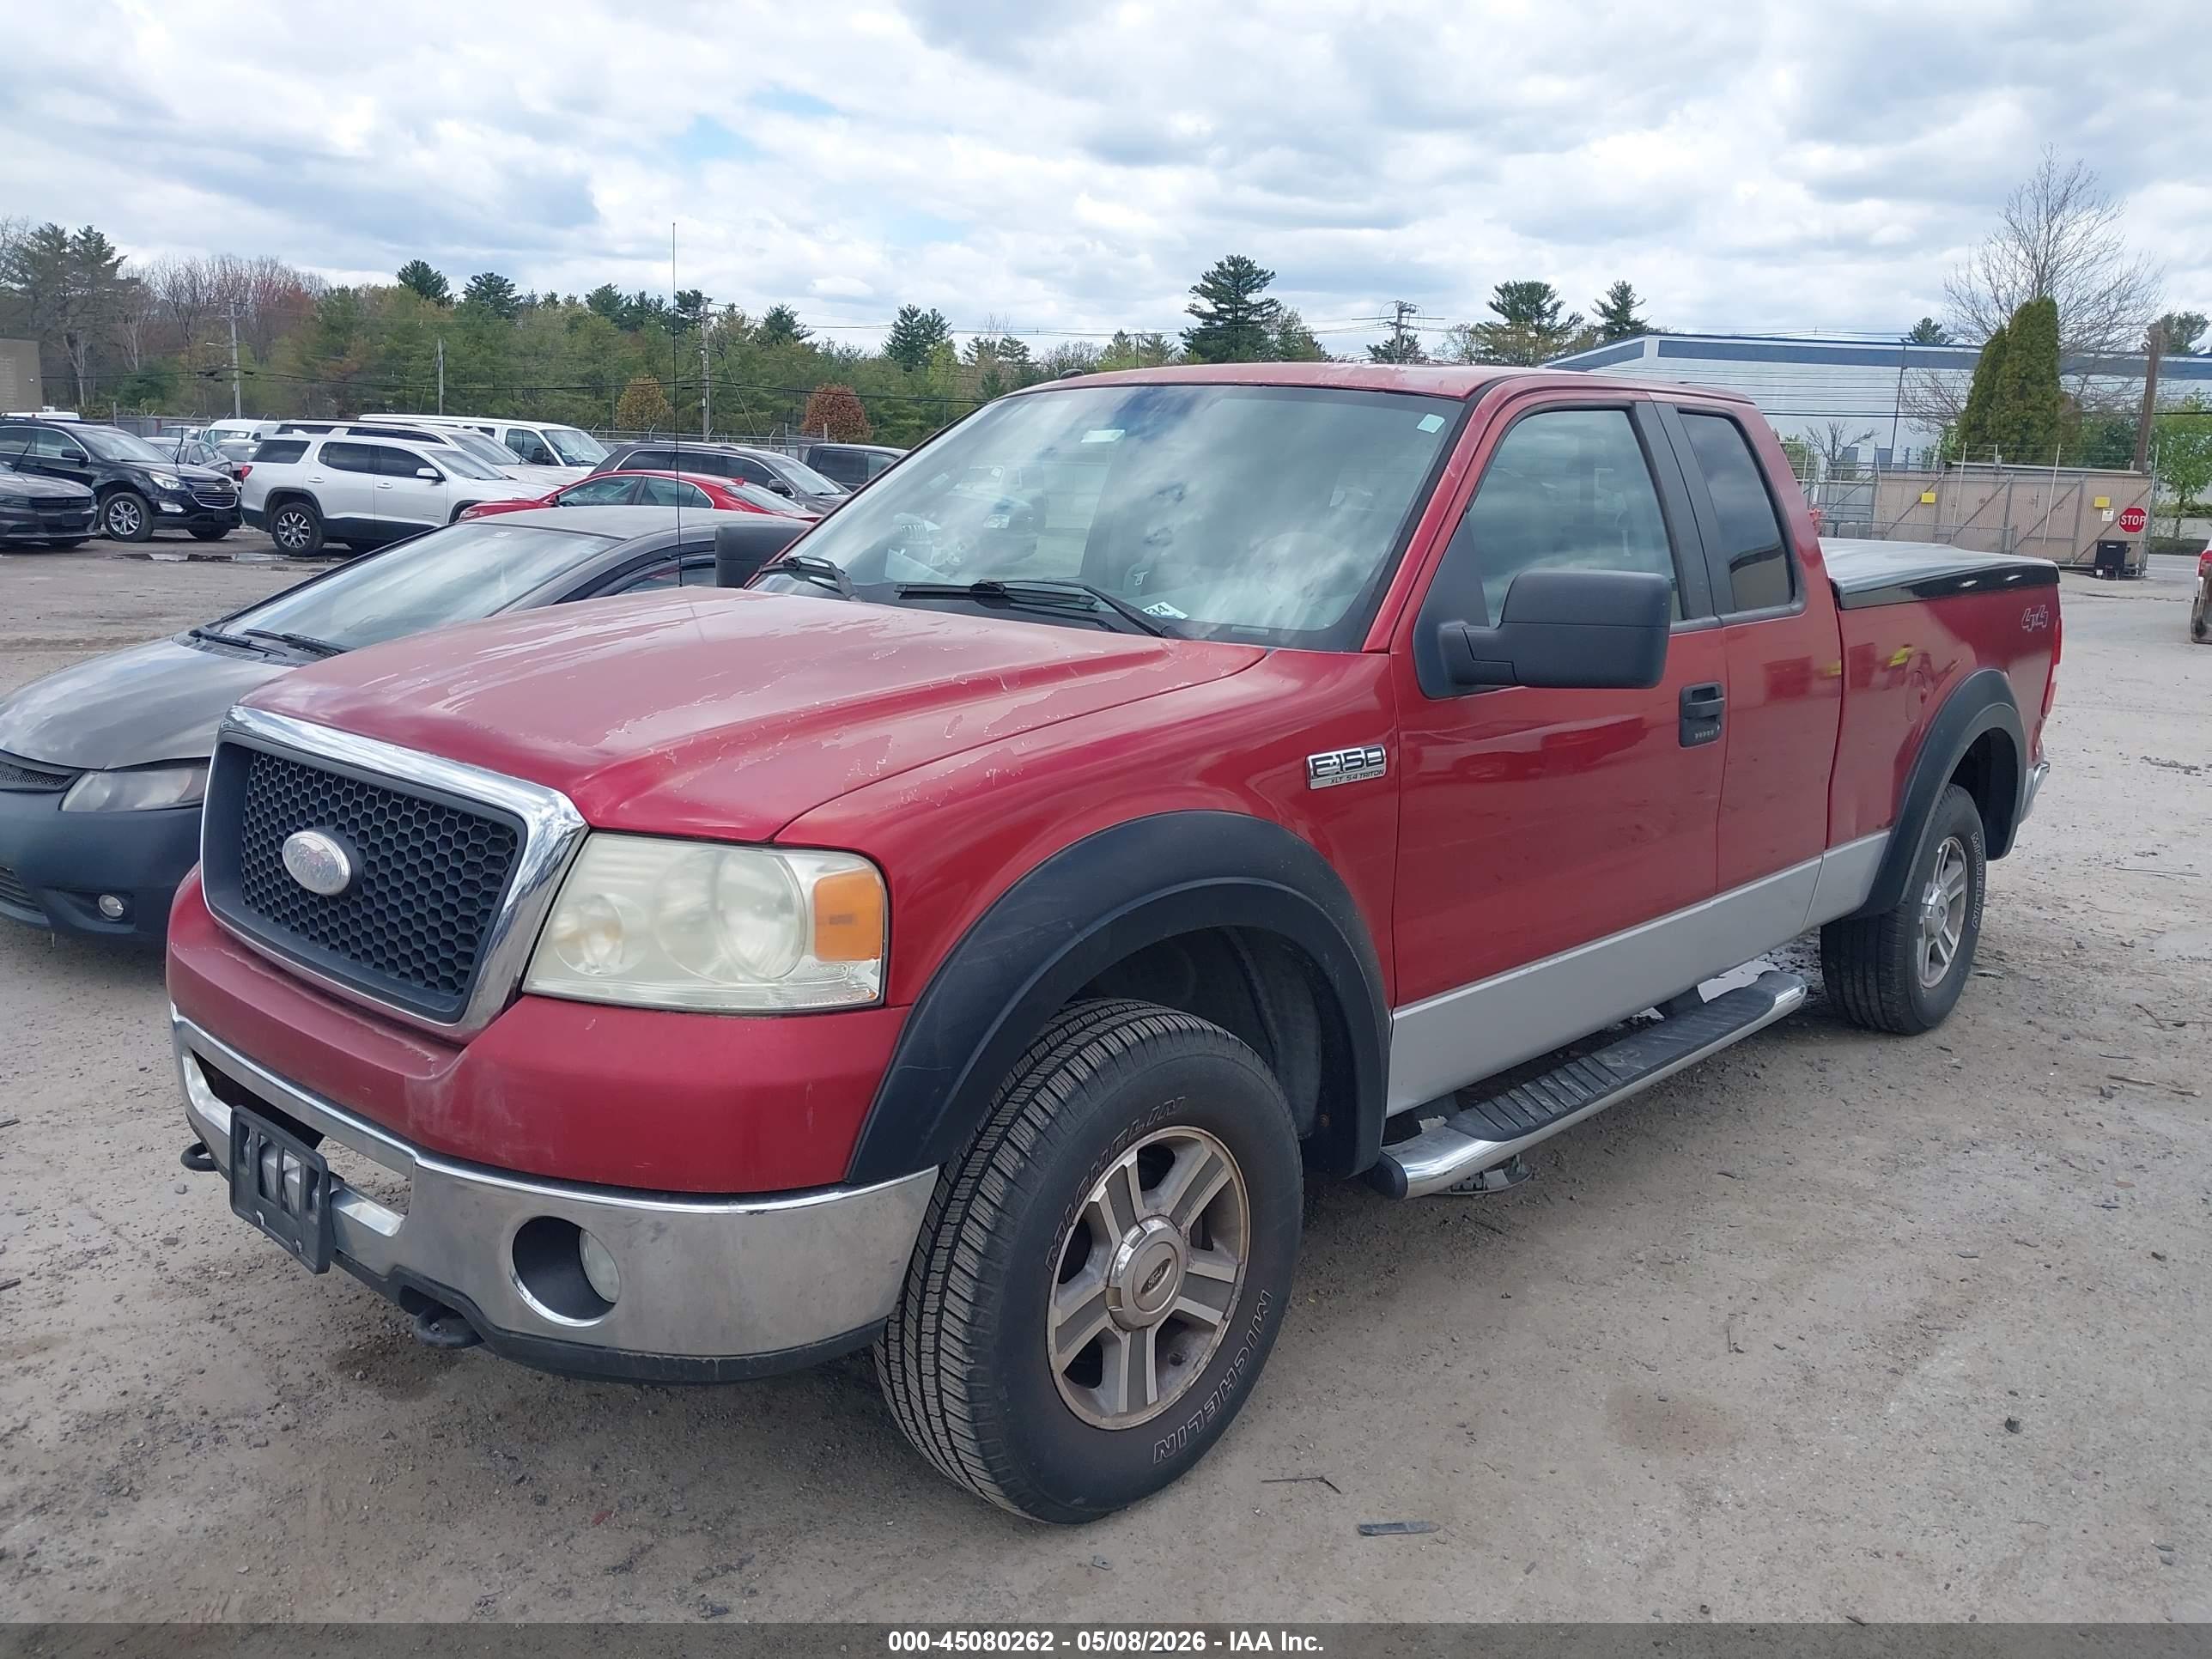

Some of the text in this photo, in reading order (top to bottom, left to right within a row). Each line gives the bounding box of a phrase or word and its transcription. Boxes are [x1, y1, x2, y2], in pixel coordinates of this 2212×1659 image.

[2120, 514, 2146, 526] STOP
[1359, 769, 1384, 780] TRITON
[1153, 1289, 1273, 1464] MICHELIN
